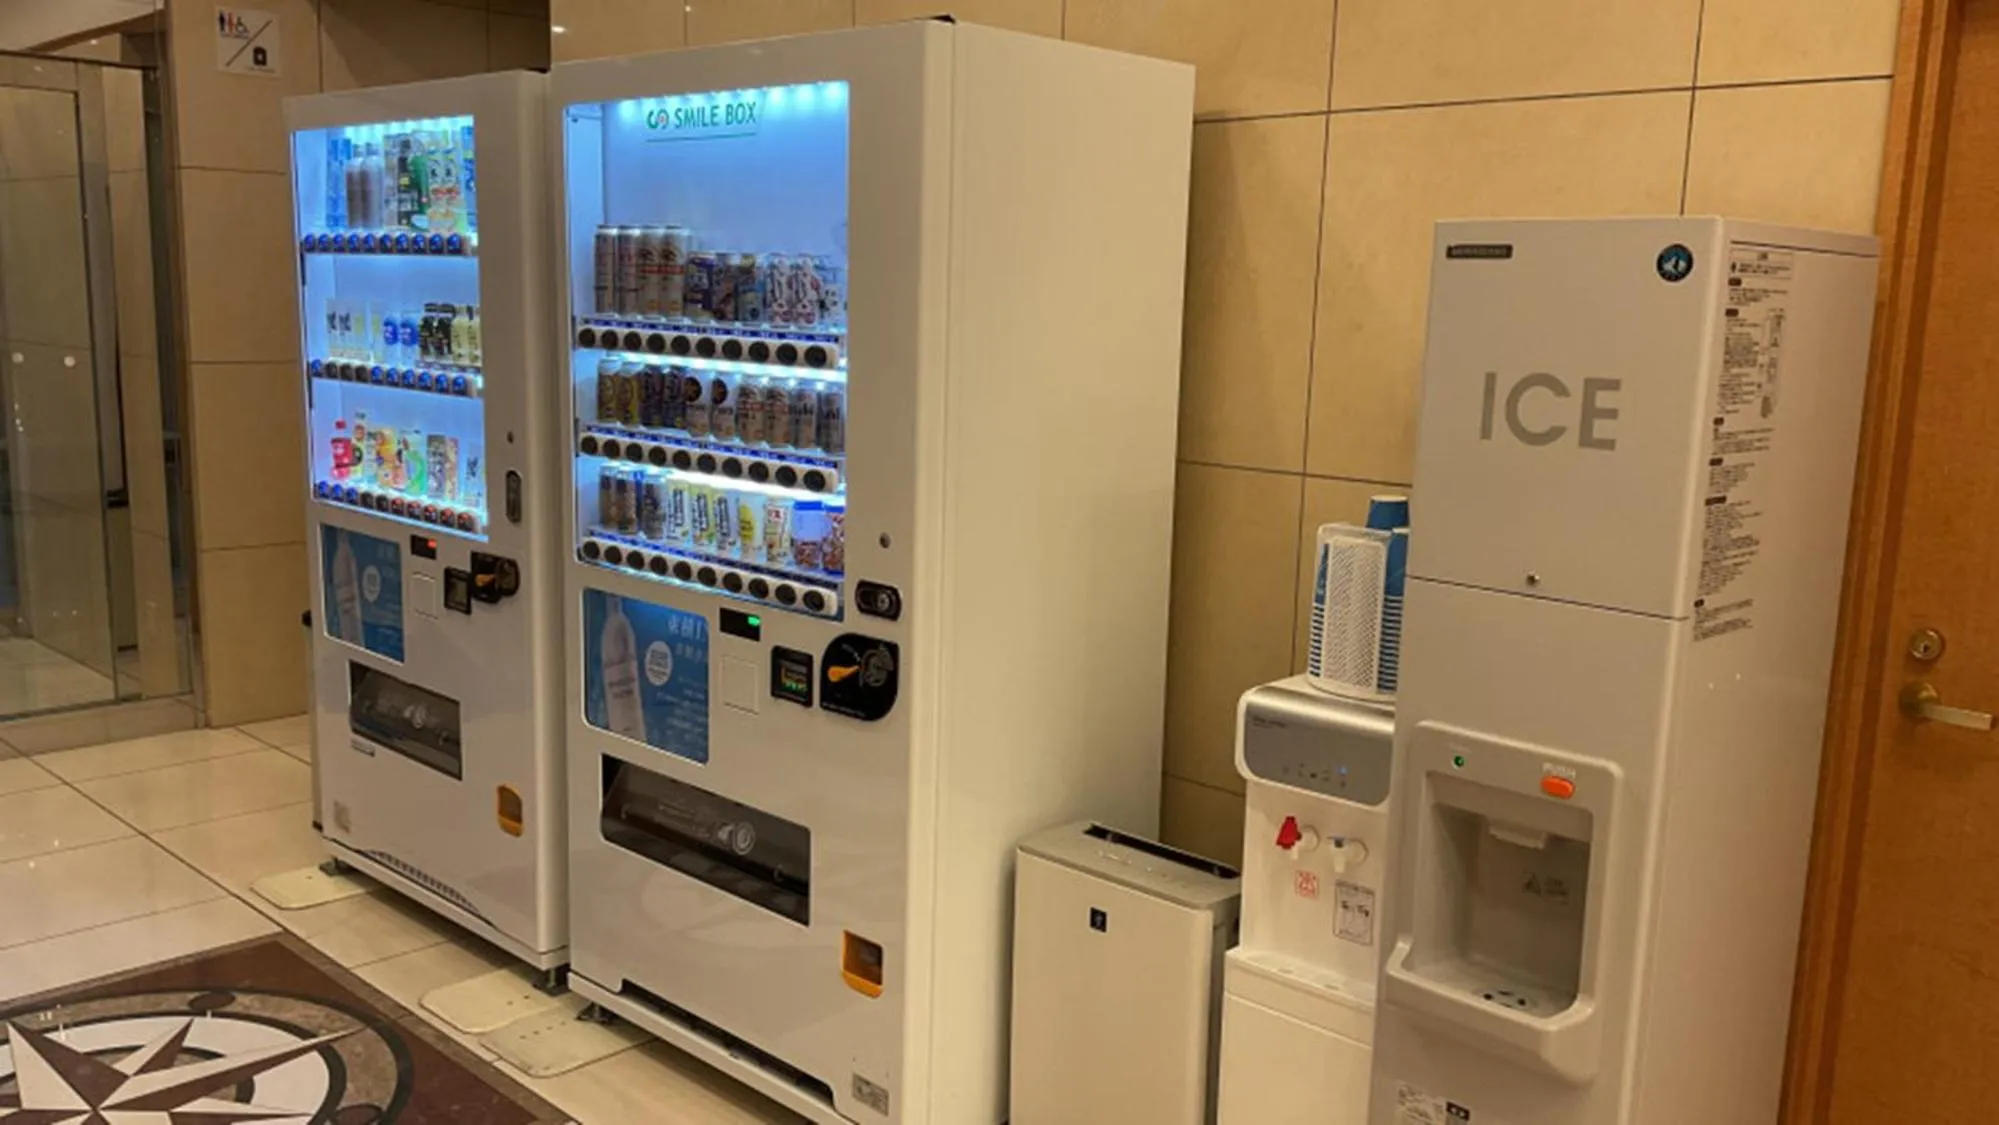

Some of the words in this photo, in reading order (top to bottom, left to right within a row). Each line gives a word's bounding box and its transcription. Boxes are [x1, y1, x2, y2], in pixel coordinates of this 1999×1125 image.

[674, 105, 720, 129] SMILE
[725, 100, 757, 126] BOX
[1479, 371, 1622, 451] ICE
